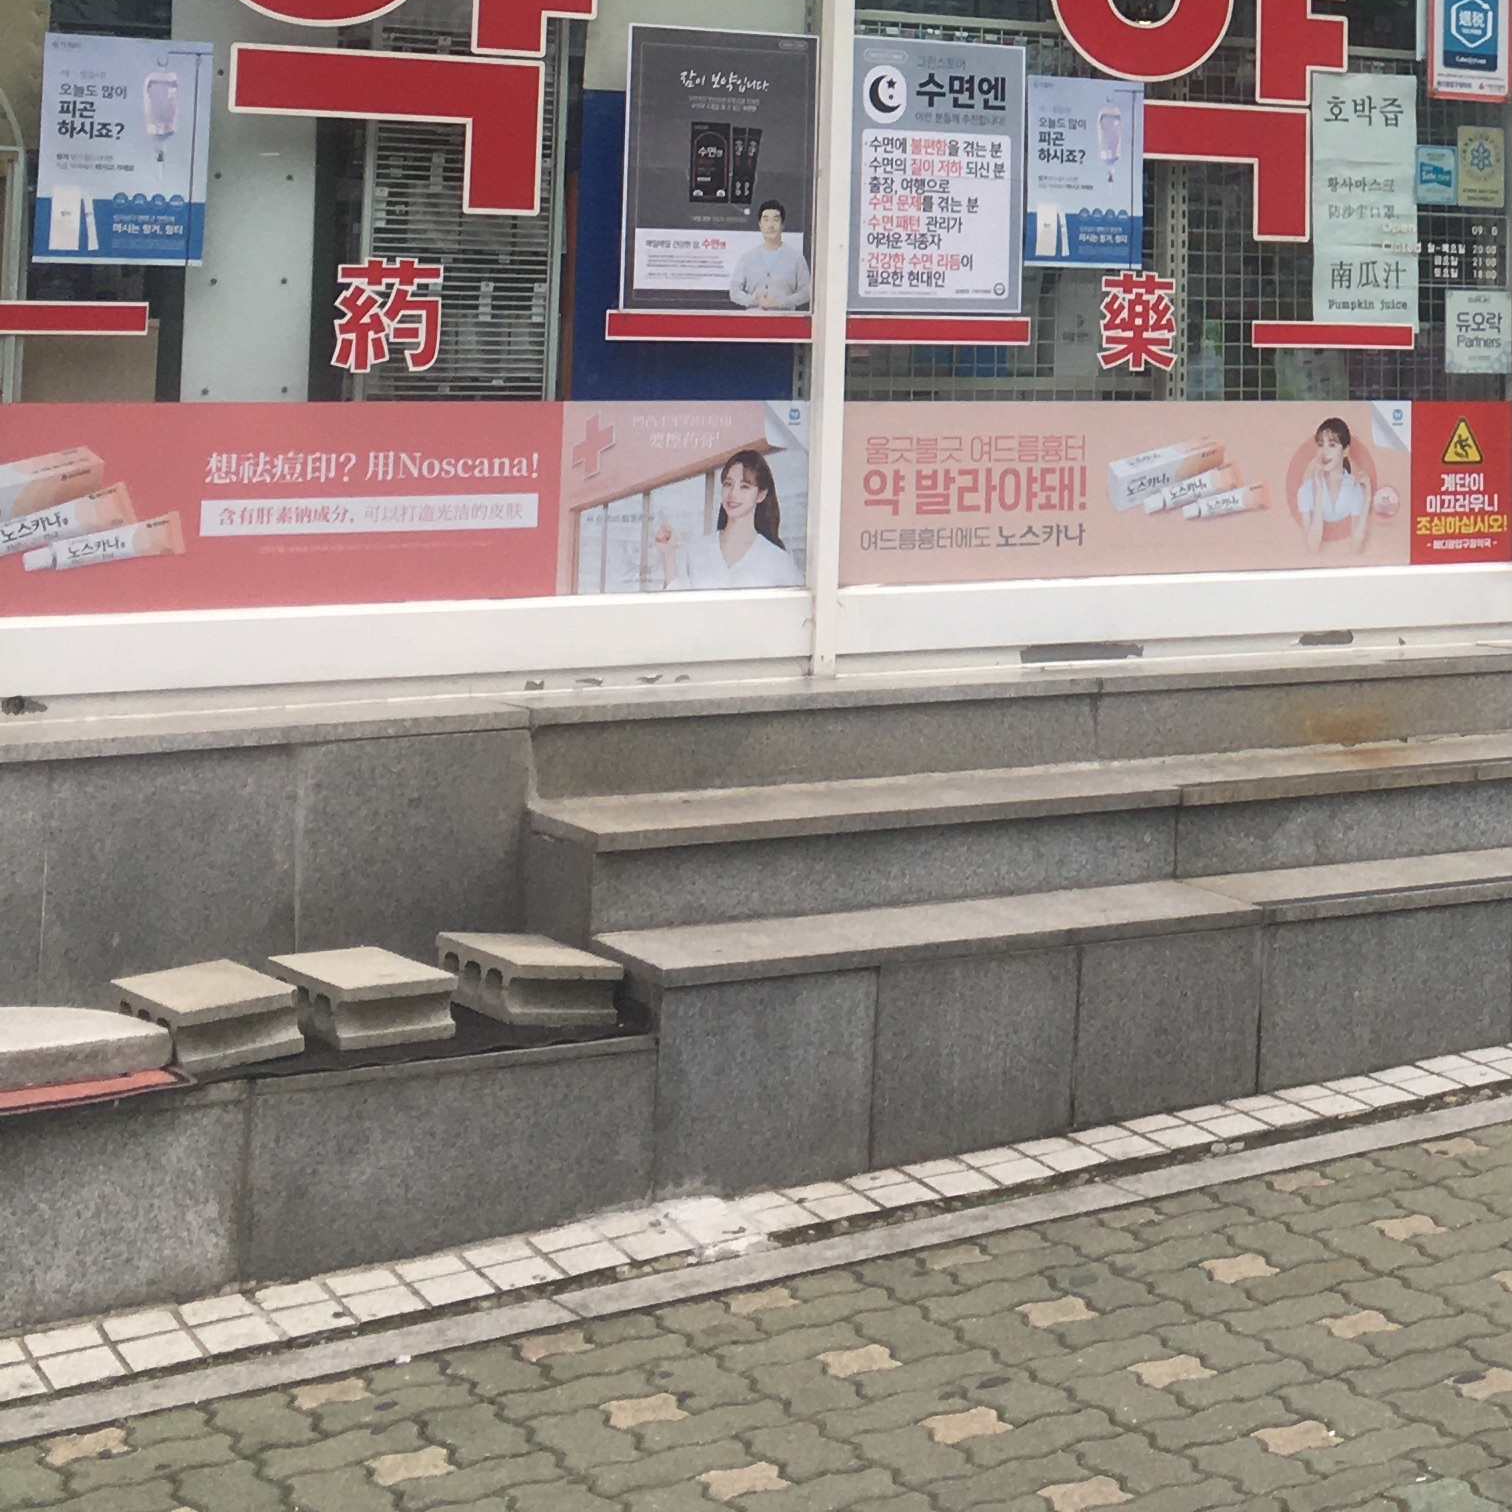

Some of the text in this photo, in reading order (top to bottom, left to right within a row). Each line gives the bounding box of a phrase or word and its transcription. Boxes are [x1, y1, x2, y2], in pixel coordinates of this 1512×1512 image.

[58, 82, 128, 99] 오늘도 많이
[916, 72, 1006, 111] 수면엔
[58, 100, 96, 119] 피곤
[1323, 94, 1404, 128] 호박즙
[57, 119, 125, 140] 하시죠?
[1038, 116, 1066, 129] 오늘도
[869, 136, 1003, 158] 수면에 불편함을 겪는 분
[1038, 131, 1065, 147] 피곤
[1038, 148, 1086, 164] 하시죠?
[869, 157, 1006, 179] 수면의 질이 저하 되신 분
[869, 175, 951, 196] 출장, 여행으로
[1327, 176, 1395, 193] 황사마스크
[868, 194, 979, 214] 수면 문제를 겪는 분
[926, 216, 963, 233] 관리가
[1382, 222, 1417, 235] Open
[867, 232, 942, 250] 어려운 직종자
[867, 252, 973, 271] 건강한 수면 리듬이
[866, 270, 945, 288] 필요한 현대인
[1330, 260, 1407, 290] 南瓜汁
[1328, 299, 1408, 311] Pumpkin juice
[1099, 271, 1177, 373] 藥
[1456, 311, 1503, 334] 듀오락
[1456, 335, 1501, 349] Partners
[865, 434, 1086, 465] 울긋불긋 여드름흉터
[863, 465, 1087, 516] 약 발라야돼!
[1440, 472, 1484, 492] 계단이
[1426, 493, 1498, 513] 미끄러우니
[1416, 514, 1508, 535] 조심하십시오!
[860, 522, 1086, 551] 여드름흉터에도 노스카나
[67, 536, 120, 560] 노스카나
